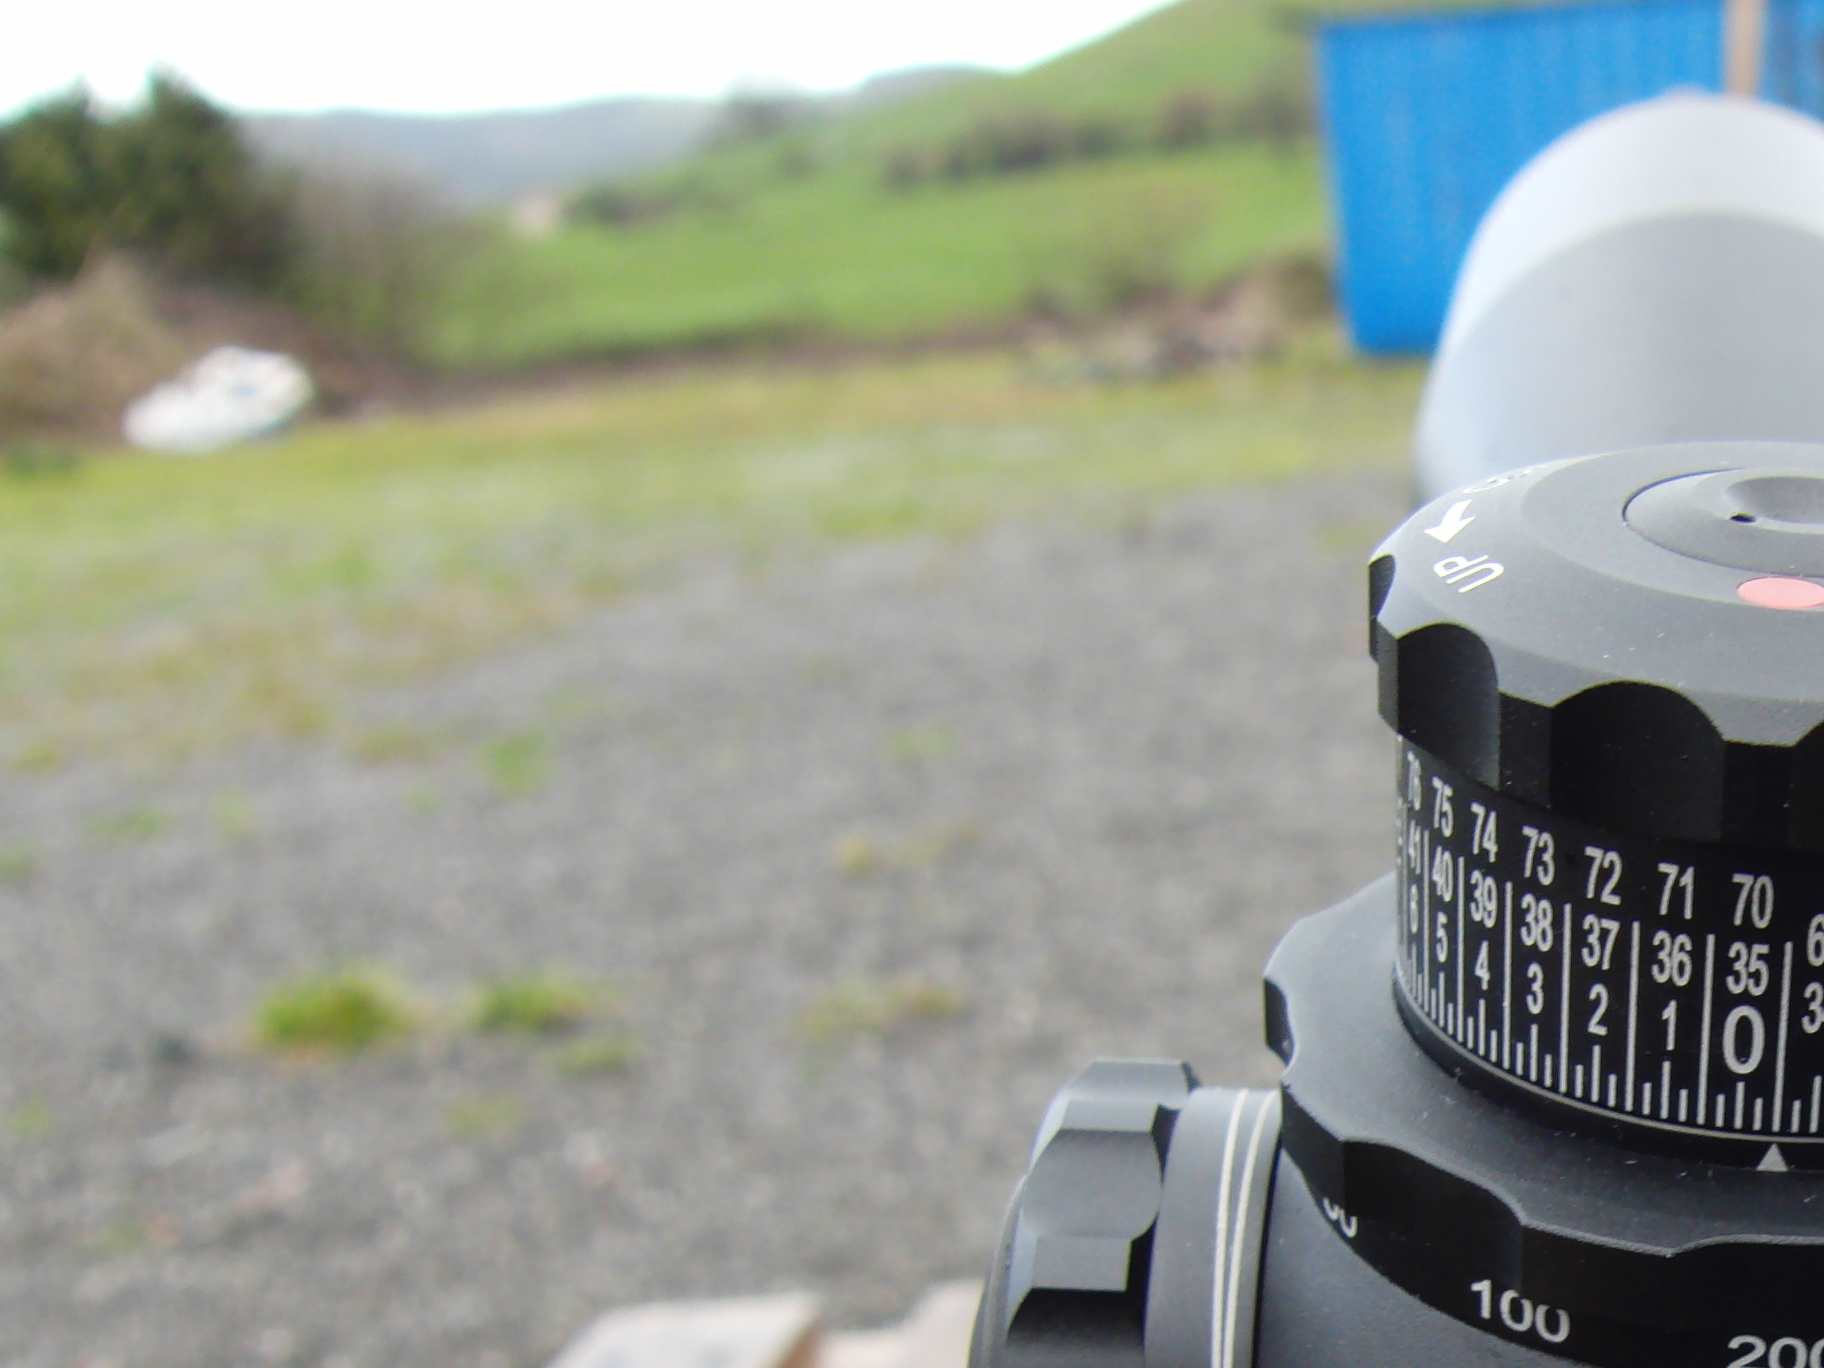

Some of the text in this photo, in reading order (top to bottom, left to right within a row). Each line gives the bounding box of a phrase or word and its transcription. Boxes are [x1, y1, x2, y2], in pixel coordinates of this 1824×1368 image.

[1433, 554, 1505, 593] UP
[1432, 776, 1453, 837] 75
[1470, 802, 1498, 862] 74
[1522, 825, 1555, 885] 73
[1585, 846, 1622, 905] 72
[1658, 862, 1695, 920] 71
[1732, 873, 1774, 929] 70
[1432, 846, 1453, 902] 40
[1470, 869, 1498, 928] 39
[1520, 893, 1553, 952] 38
[1582, 914, 1620, 970] 37
[1651, 930, 1692, 987] 36
[1725, 941, 1770, 996] 35
[1436, 911, 1448, 963] 5
[1474, 940, 1490, 991] 4
[1526, 962, 1544, 1014] 3
[1587, 984, 1608, 1036] 2
[1661, 999, 1677, 1051] 1
[1722, 1005, 1765, 1075] 0
[1471, 1279, 1571, 1343] 100
